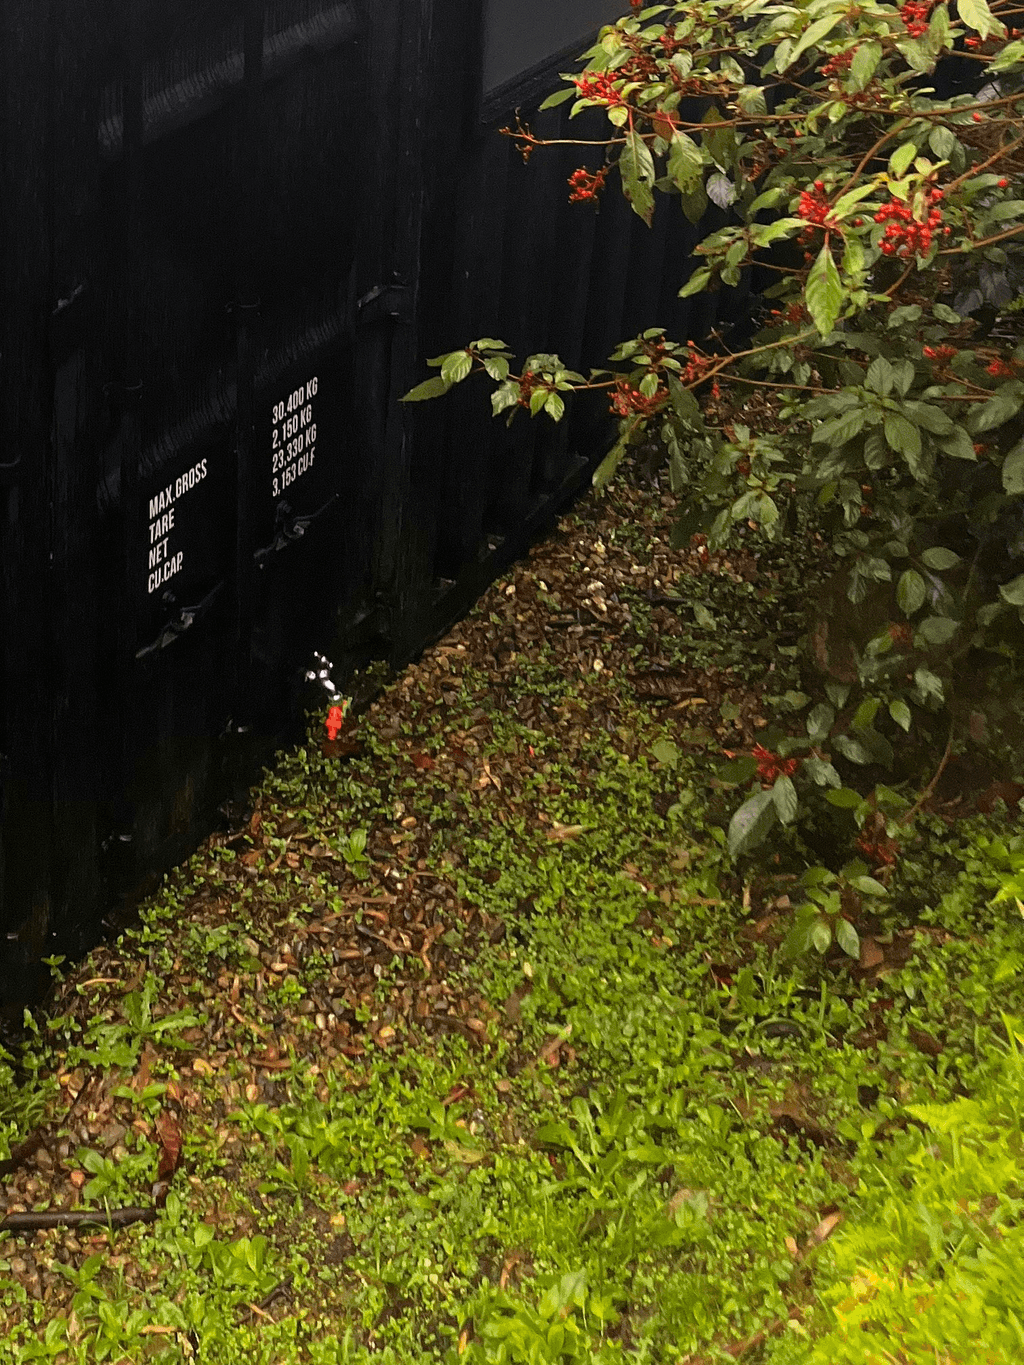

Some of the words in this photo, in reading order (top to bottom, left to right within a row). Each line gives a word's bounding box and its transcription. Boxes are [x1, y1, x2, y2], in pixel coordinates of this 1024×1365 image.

[306, 376, 319, 400] KG
[148, 507, 175, 545] TARE
[300, 403, 312, 429] KG
[148, 536, 170, 570] NET
[305, 422, 317, 448] KG
